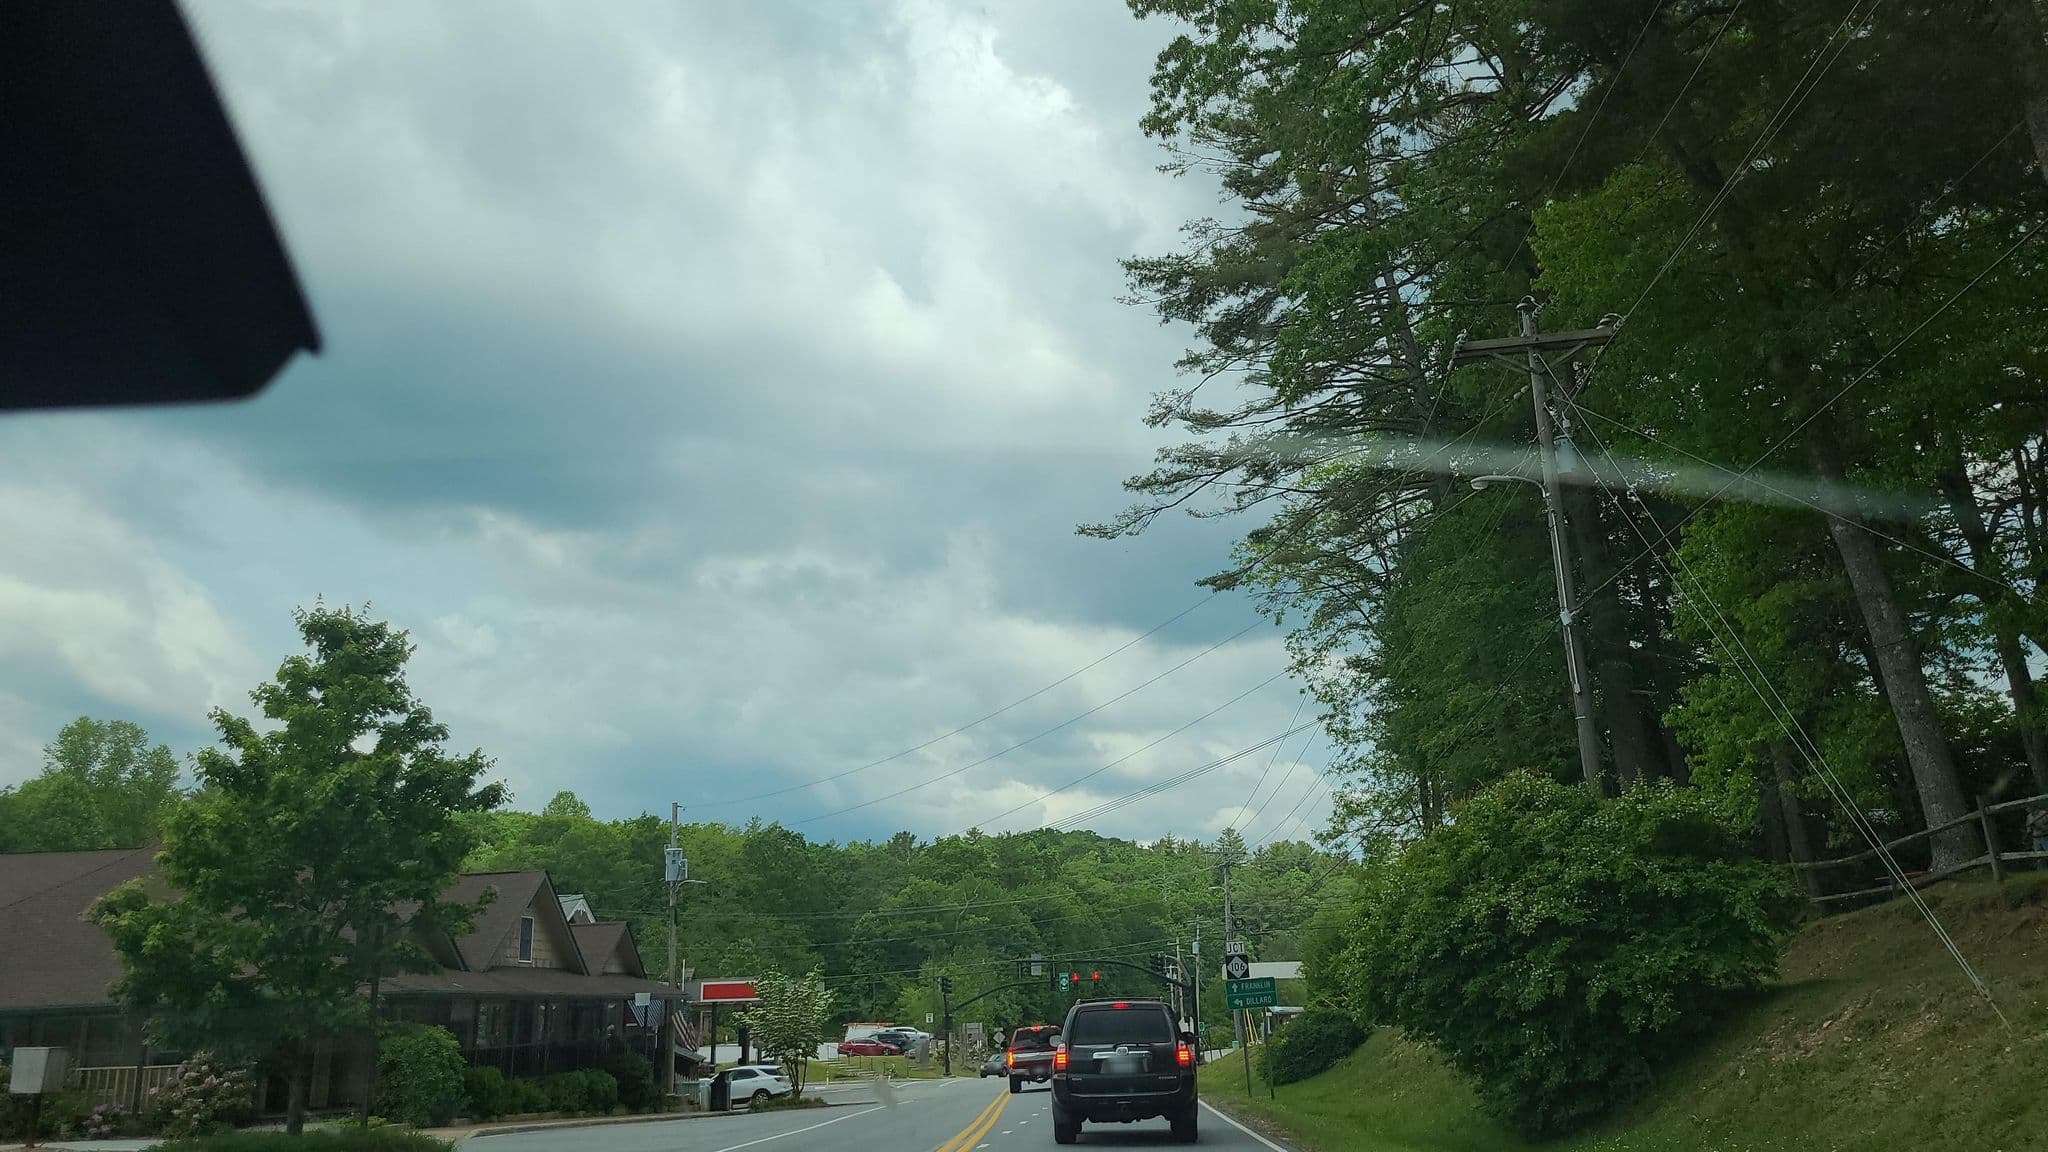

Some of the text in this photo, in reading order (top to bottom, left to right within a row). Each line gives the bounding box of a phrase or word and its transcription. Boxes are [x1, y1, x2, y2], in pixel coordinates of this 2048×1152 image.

[1228, 943, 1243, 953] JCT
[1231, 963, 1245, 971] 106
[1241, 981, 1270, 990] FRANKLIN
[1246, 996, 1272, 1005] DILLARD
